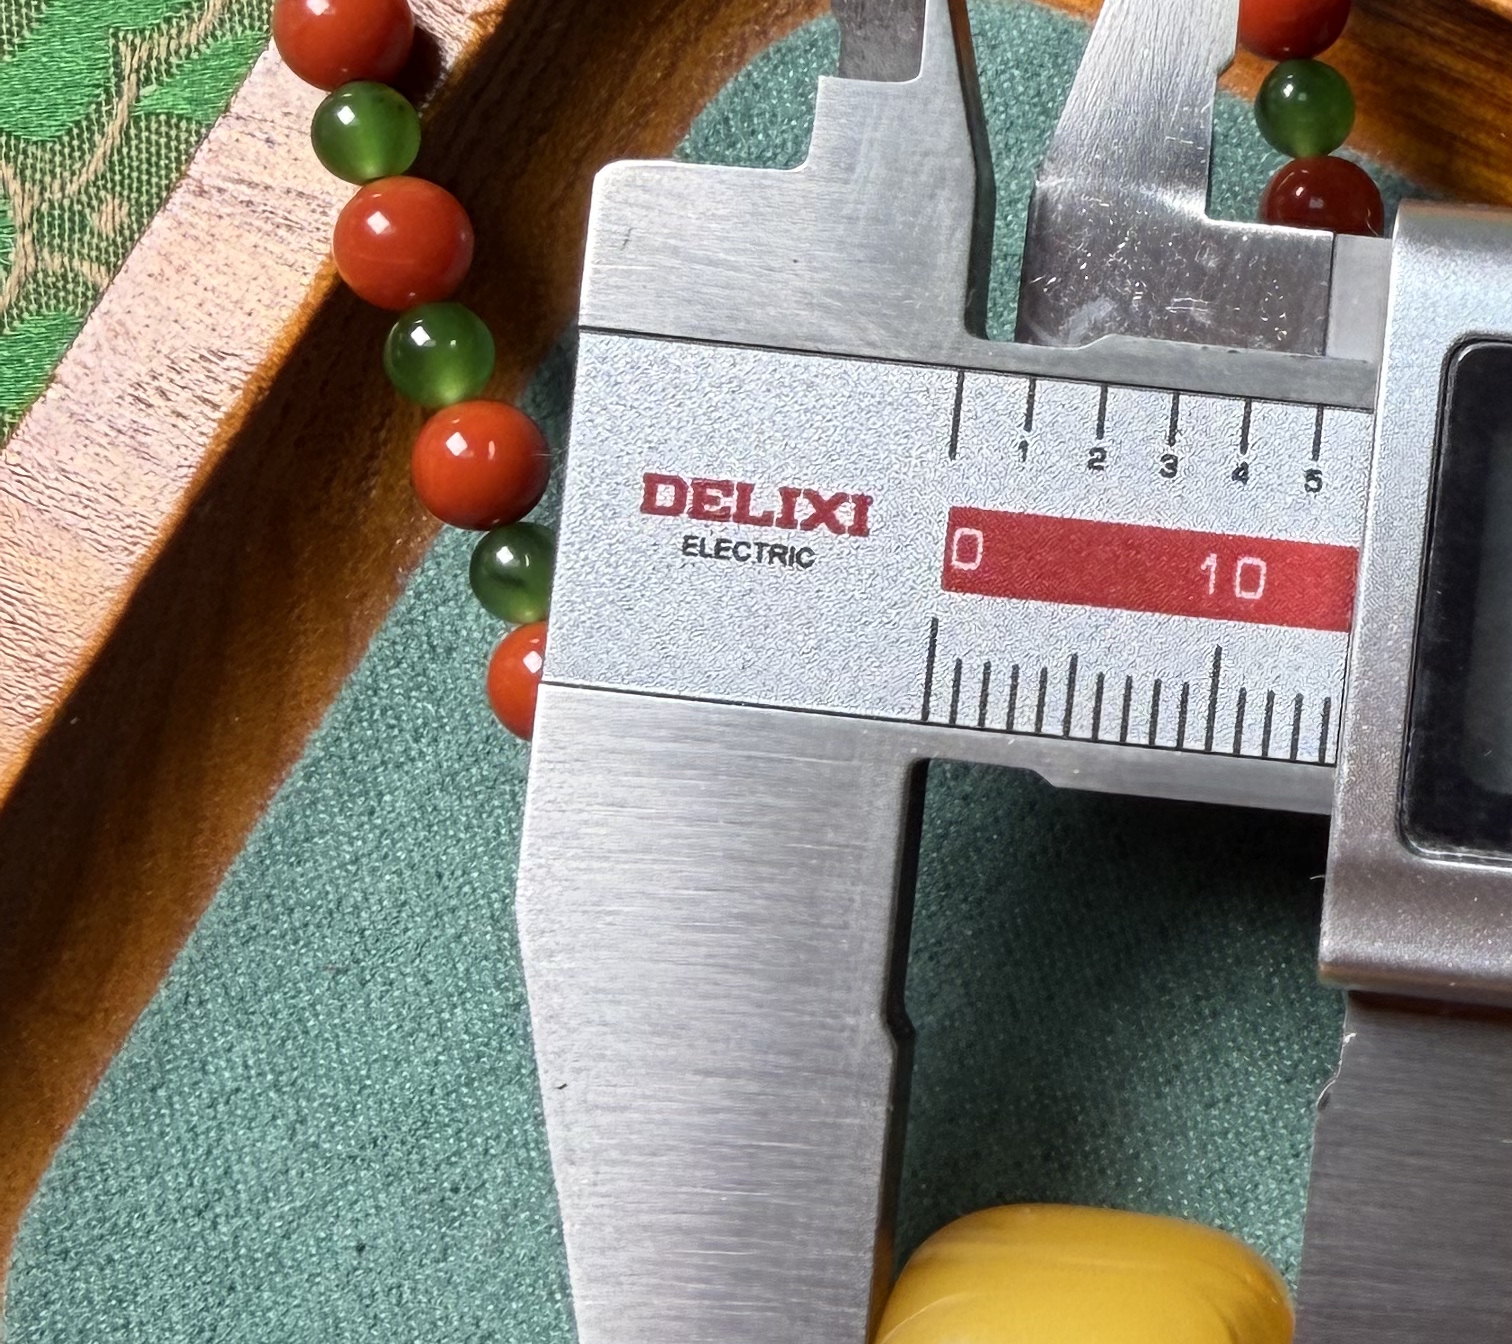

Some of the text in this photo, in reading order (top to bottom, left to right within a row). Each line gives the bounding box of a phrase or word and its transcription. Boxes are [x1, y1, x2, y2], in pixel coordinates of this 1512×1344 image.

[1018, 438, 1323, 492] 1 2 3 4 5
[640, 473, 873, 537] DELIXI
[681, 535, 816, 568] ELECTRIC
[951, 527, 1268, 599] 0 10
